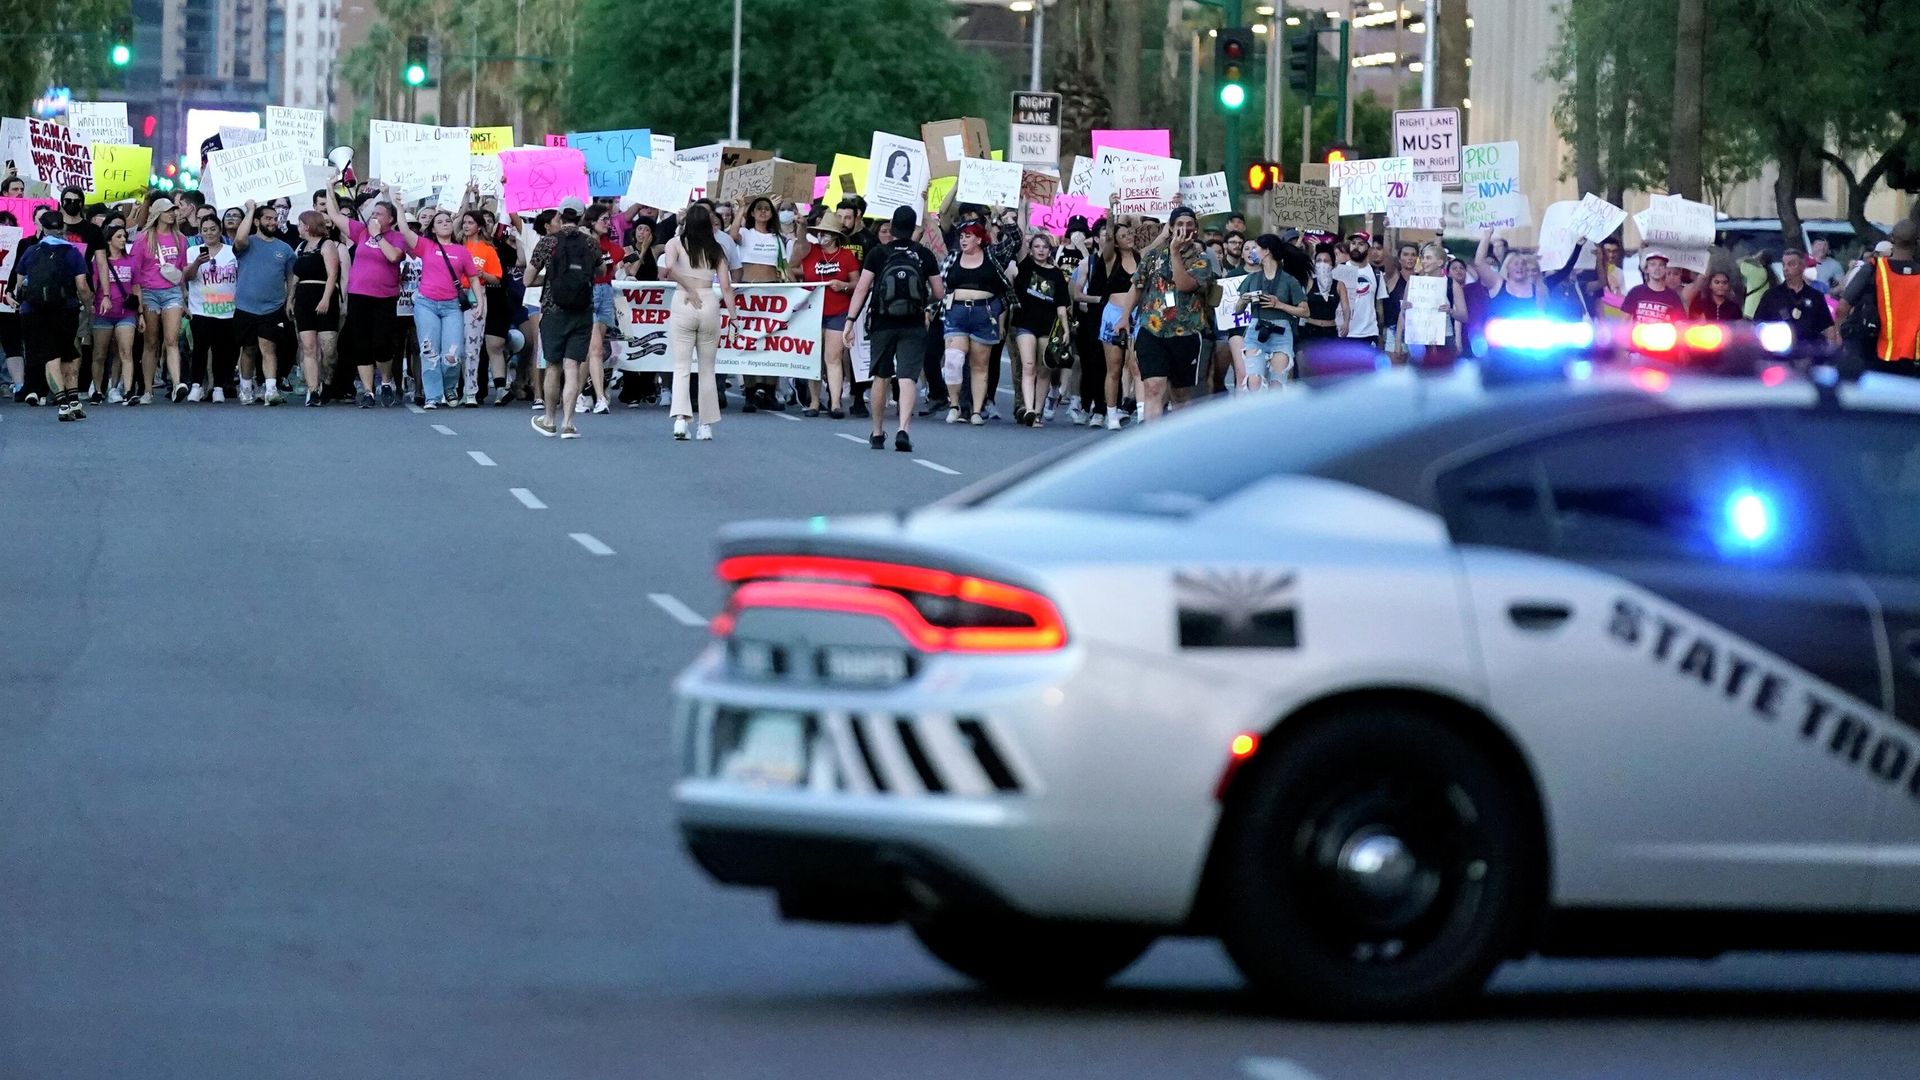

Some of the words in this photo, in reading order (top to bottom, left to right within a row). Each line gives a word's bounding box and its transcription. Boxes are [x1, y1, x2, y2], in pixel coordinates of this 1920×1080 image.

[1019, 95, 1053, 108] RIGHT
[77, 116, 112, 128] WANTED
[112, 118, 127, 128] THE
[1019, 111, 1051, 123] LANE
[1399, 118, 1425, 127] RIGHT
[1430, 117, 1454, 127] LANE
[29, 119, 39, 135] I
[42, 122, 60, 139] AM
[61, 126, 71, 142] A
[91, 128, 127, 138] RNMENT
[1018, 131, 1051, 142] BUSES
[31, 135, 63, 153] WOMAN
[64, 141, 82, 157] NOT
[83, 146, 90, 160] A
[1402, 133, 1452, 151] MUST
[1021, 145, 1047, 155] ONLY
[1465, 146, 1499, 169] PRO
[61, 155, 93, 178] PARENT
[1331, 161, 1376, 178] PISSED
[1382, 158, 1407, 171] OFF
[1413, 158, 1426, 166] RN
[1430, 156, 1455, 167] RIGHT
[37, 166, 53, 183] BY
[56, 169, 94, 192] CHOICE
[103, 168, 133, 182] OFF
[220, 163, 242, 182] YOU
[587, 169, 611, 188] TICE
[1073, 166, 1094, 186] GET
[1414, 174, 1429, 182] EPT
[1432, 173, 1457, 182] BUSES
[1464, 169, 1500, 184] CHOICE
[1125, 186, 1160, 198] DESERVE
[1276, 183, 1295, 196] MY
[1479, 177, 1512, 198] NOW
[1051, 201, 1076, 217] MY
[1116, 201, 1146, 214] HUMAN
[1274, 196, 1318, 209] BIGGER
[1352, 195, 1388, 213] MAM
[1465, 201, 1486, 216] PRO
[1273, 209, 1304, 224] YOUR
[1304, 211, 1336, 225] DICK
[472, 256, 486, 267] GE
[1062, 256, 1079, 264] PIT
[623, 288, 665, 305] WE
[720, 294, 788, 314] AND
[1638, 302, 1668, 313] MAKE
[717, 336, 757, 351] TICE
[764, 336, 815, 356] NOW
[747, 360, 788, 369] Reproductive
[789, 363, 811, 371] Justice
[1608, 597, 1788, 724] STATE
[1797, 689, 1920, 803] TRO
